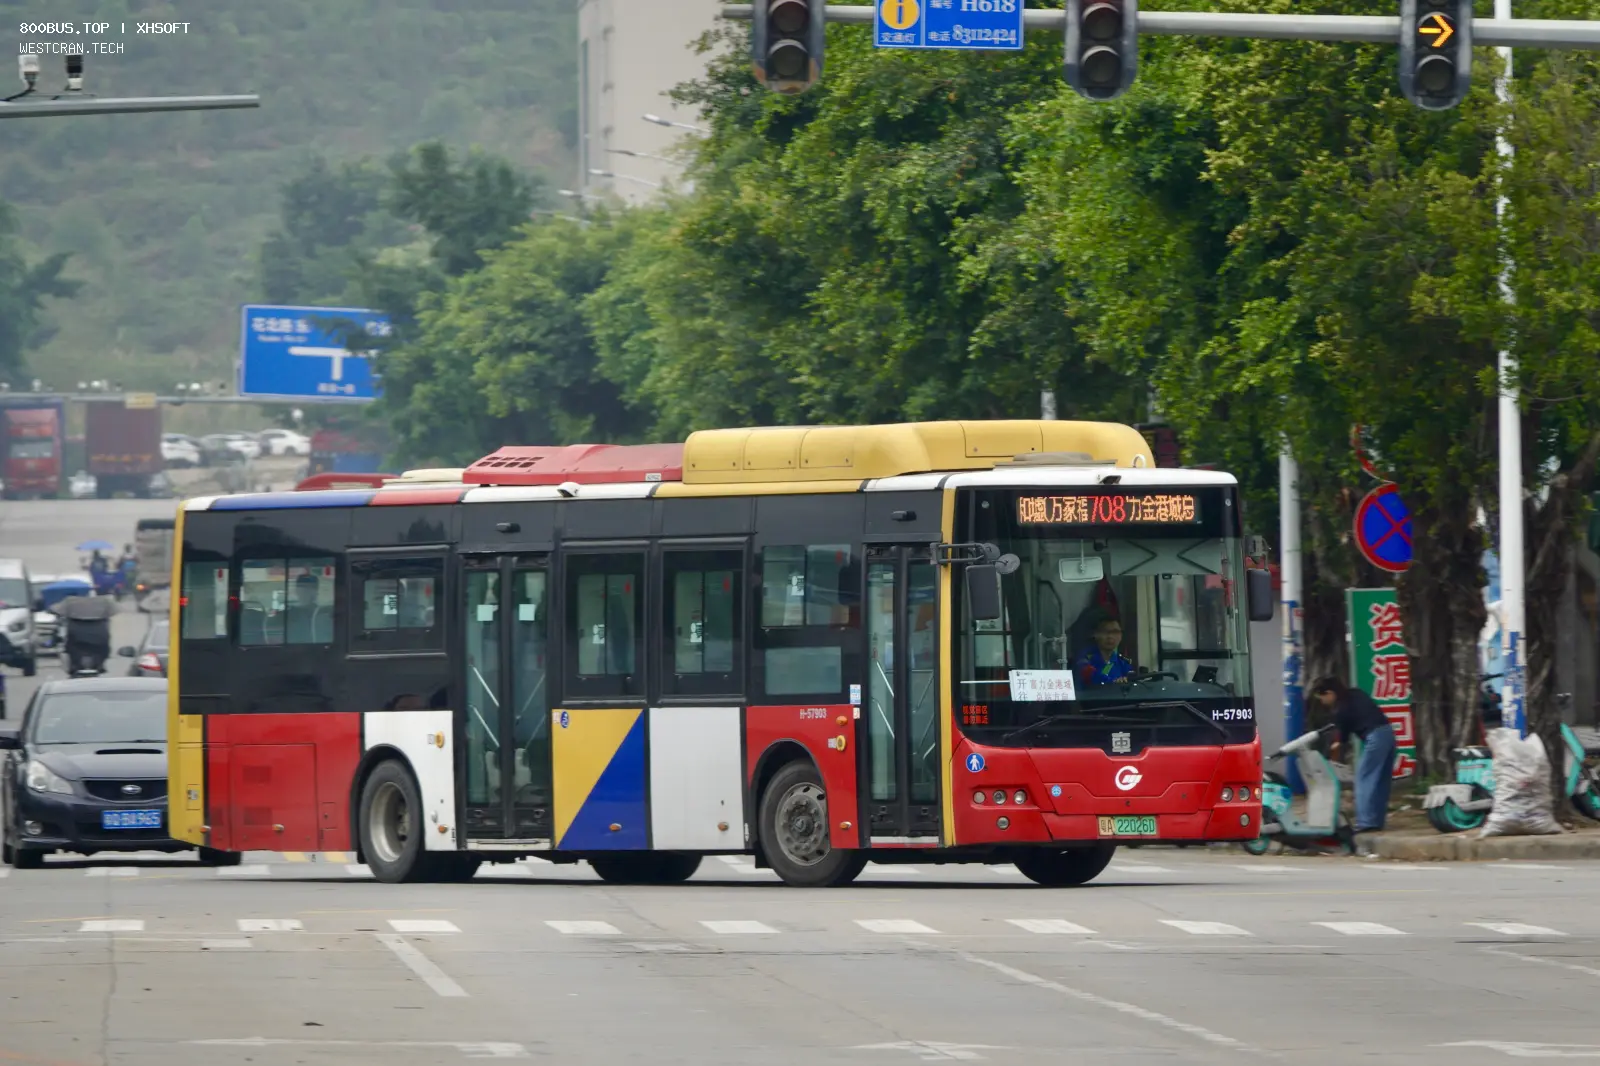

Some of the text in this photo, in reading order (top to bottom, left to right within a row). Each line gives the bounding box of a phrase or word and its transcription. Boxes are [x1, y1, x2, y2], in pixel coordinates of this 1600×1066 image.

[960, 0, 1016, 13] H618
[880, 32, 917, 44] 交通灯
[928, 24, 1017, 44] 电话 83112424
[1088, 495, 1127, 523] 708
[1212, 708, 1253, 721] H-57903
